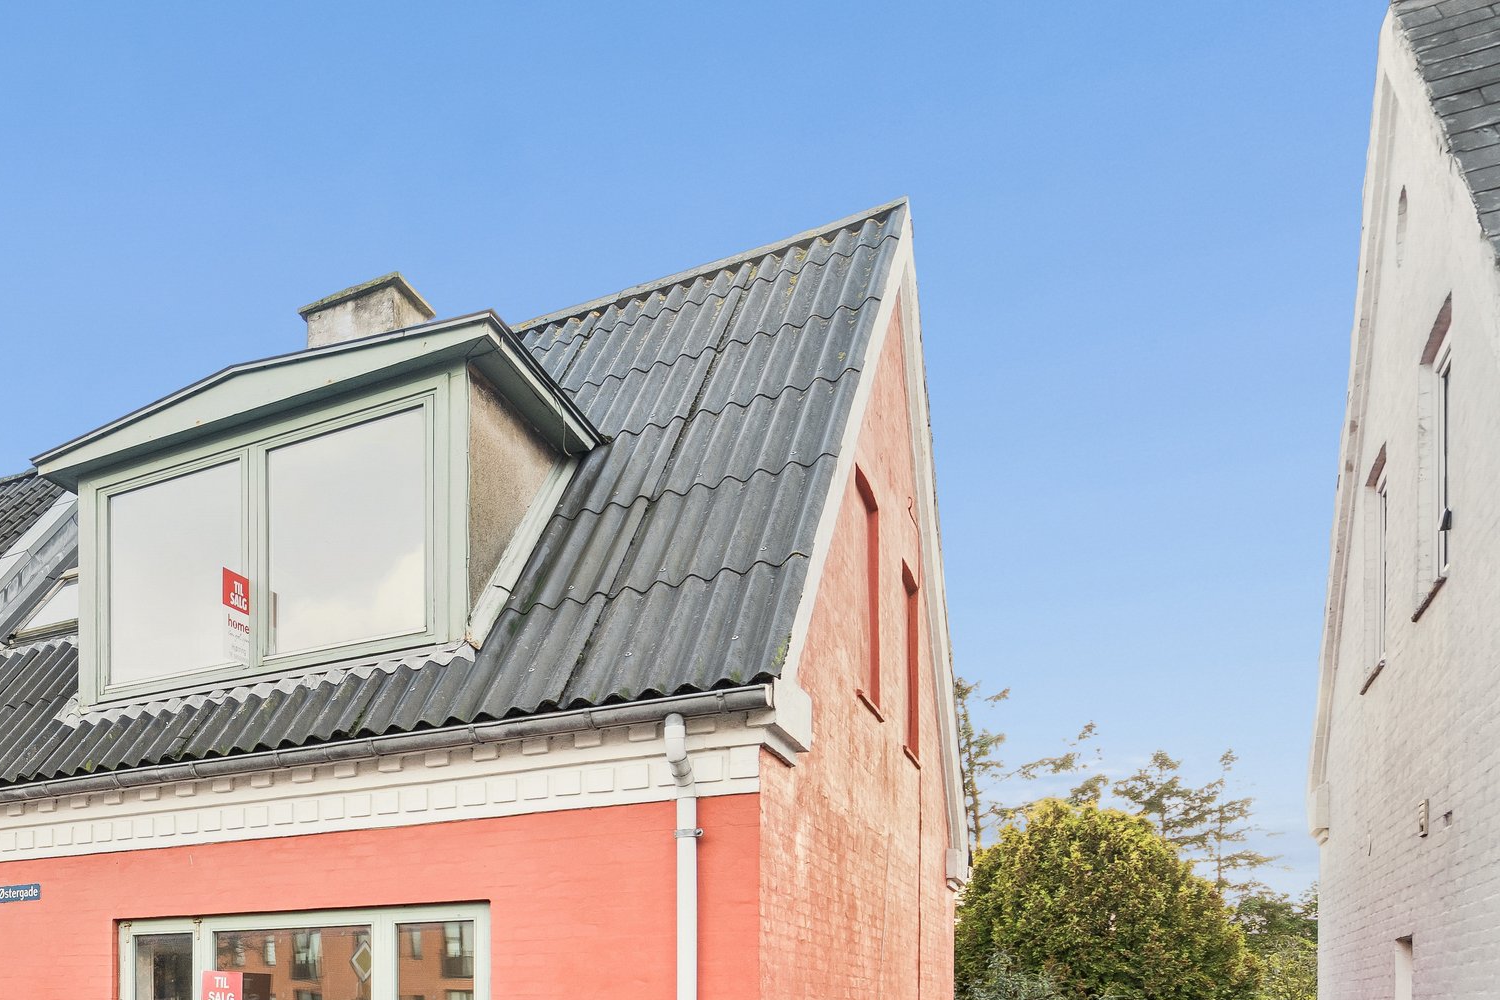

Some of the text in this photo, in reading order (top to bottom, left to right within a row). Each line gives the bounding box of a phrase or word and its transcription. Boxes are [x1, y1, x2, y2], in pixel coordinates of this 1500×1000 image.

[233, 580, 244, 596] TIL
[229, 592, 248, 611] SALG
[227, 613, 250, 634] home
[214, 976, 229, 989] TIL
